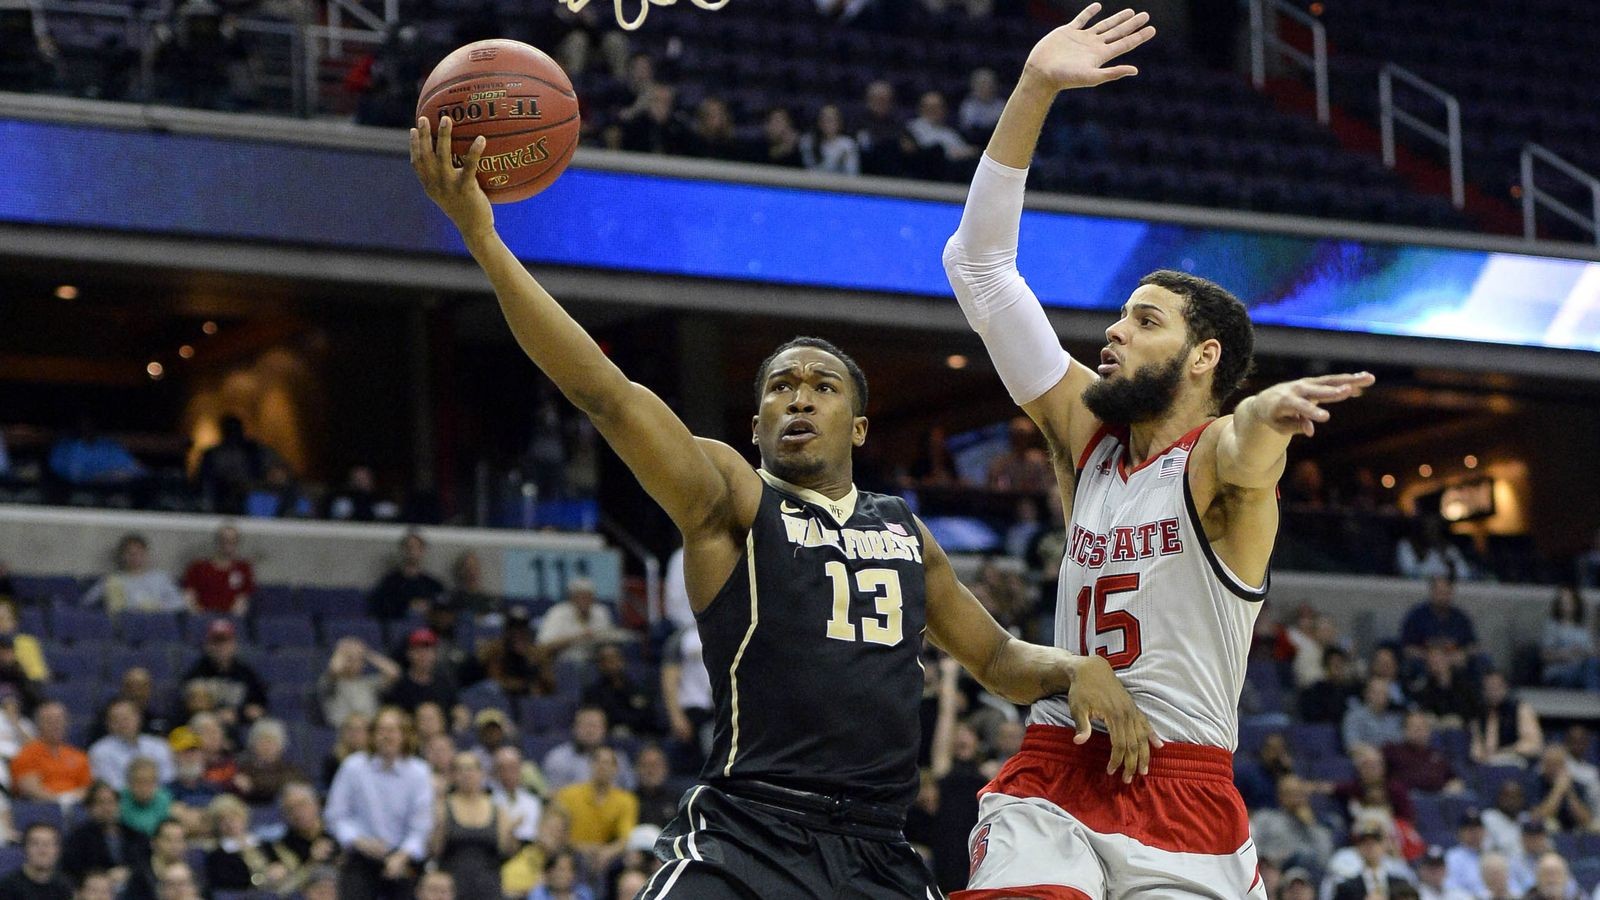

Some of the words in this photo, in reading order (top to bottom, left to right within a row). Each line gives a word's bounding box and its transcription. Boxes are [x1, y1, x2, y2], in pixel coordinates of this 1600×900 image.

[467, 89, 507, 101] LEGACY
[451, 136, 549, 173] SPALD
[829, 503, 844, 519] WF
[781, 513, 842, 548] WA
[841, 528, 923, 564] FOREST
[1068, 523, 1096, 568] NC
[1088, 517, 1184, 569] SATE
[825, 560, 904, 647] 13
[1076, 572, 1142, 671] 15
